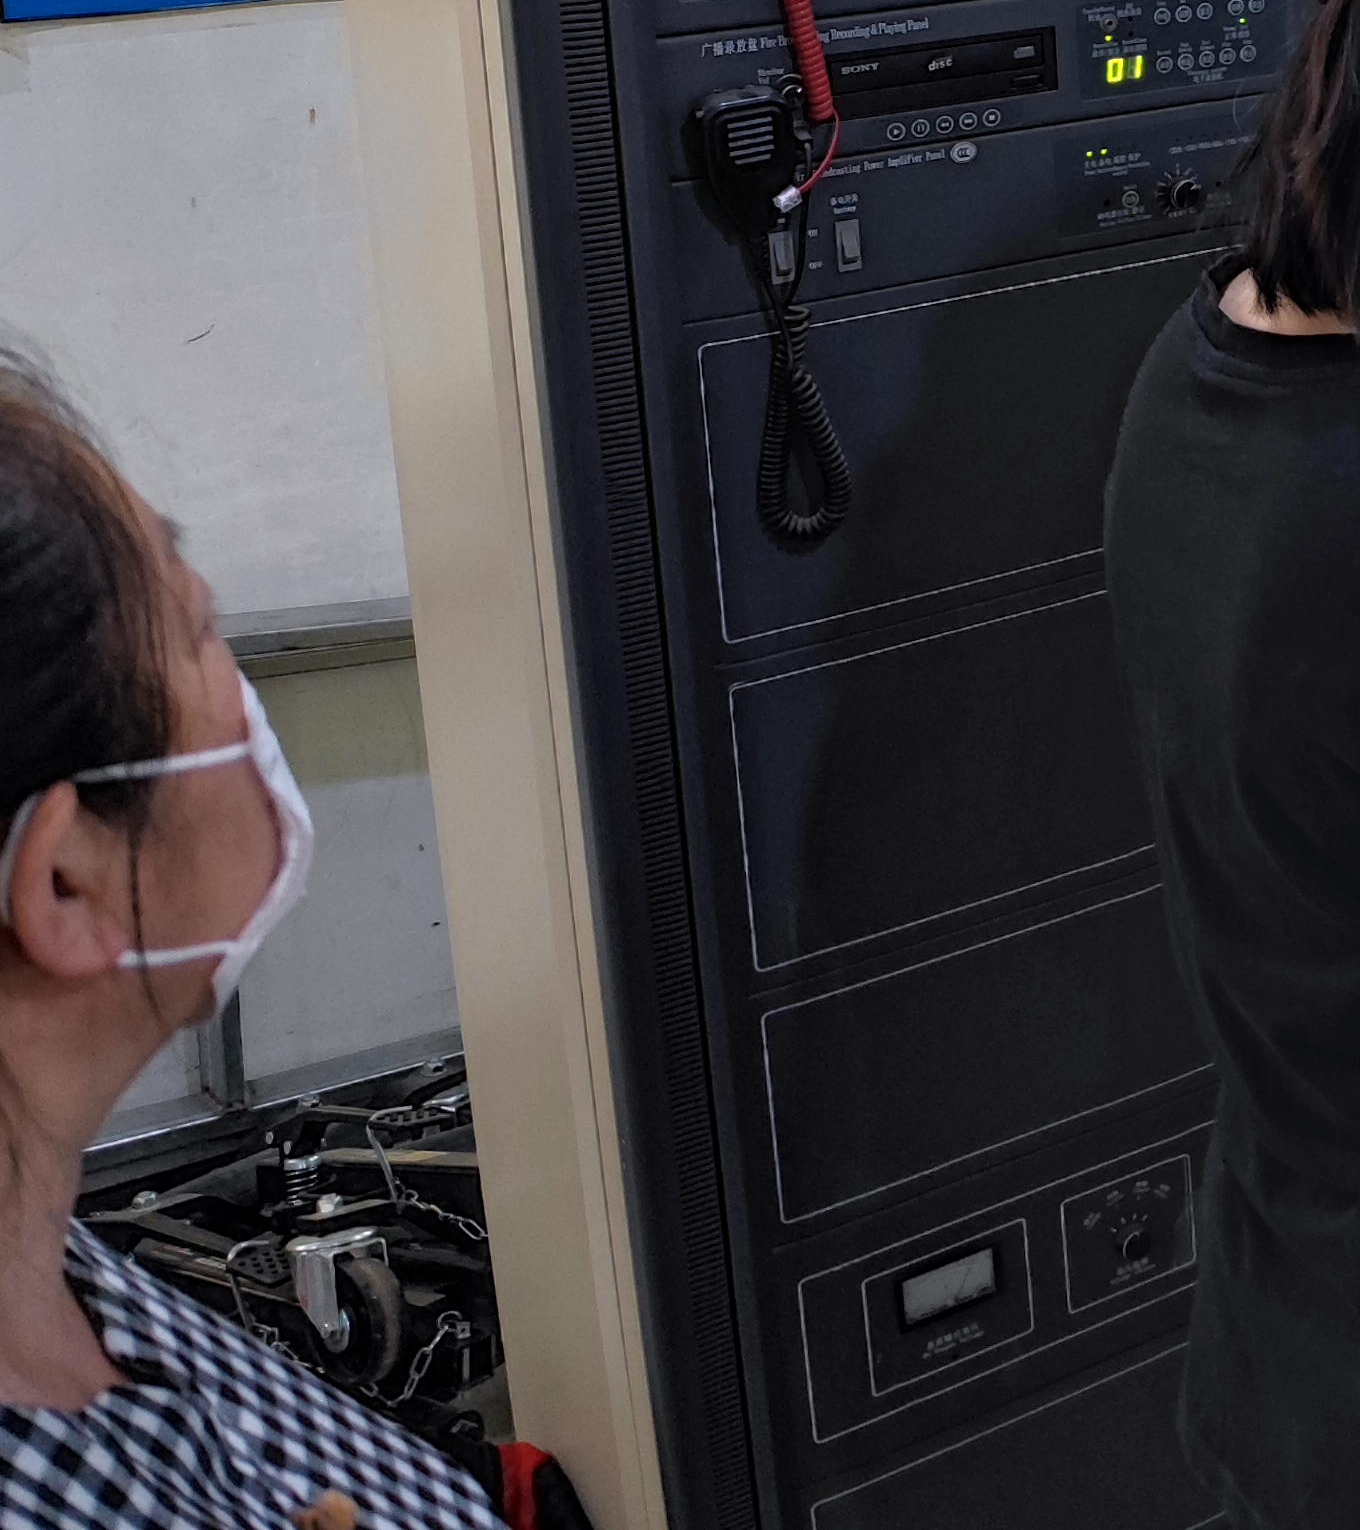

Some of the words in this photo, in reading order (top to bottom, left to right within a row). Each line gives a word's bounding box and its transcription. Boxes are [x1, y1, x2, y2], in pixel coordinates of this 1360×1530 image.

[830, 25, 870, 41] Recording
[908, 17, 929, 31] Panel
[841, 62, 880, 75] SONY
[1106, 55, 1143, 84] 01
